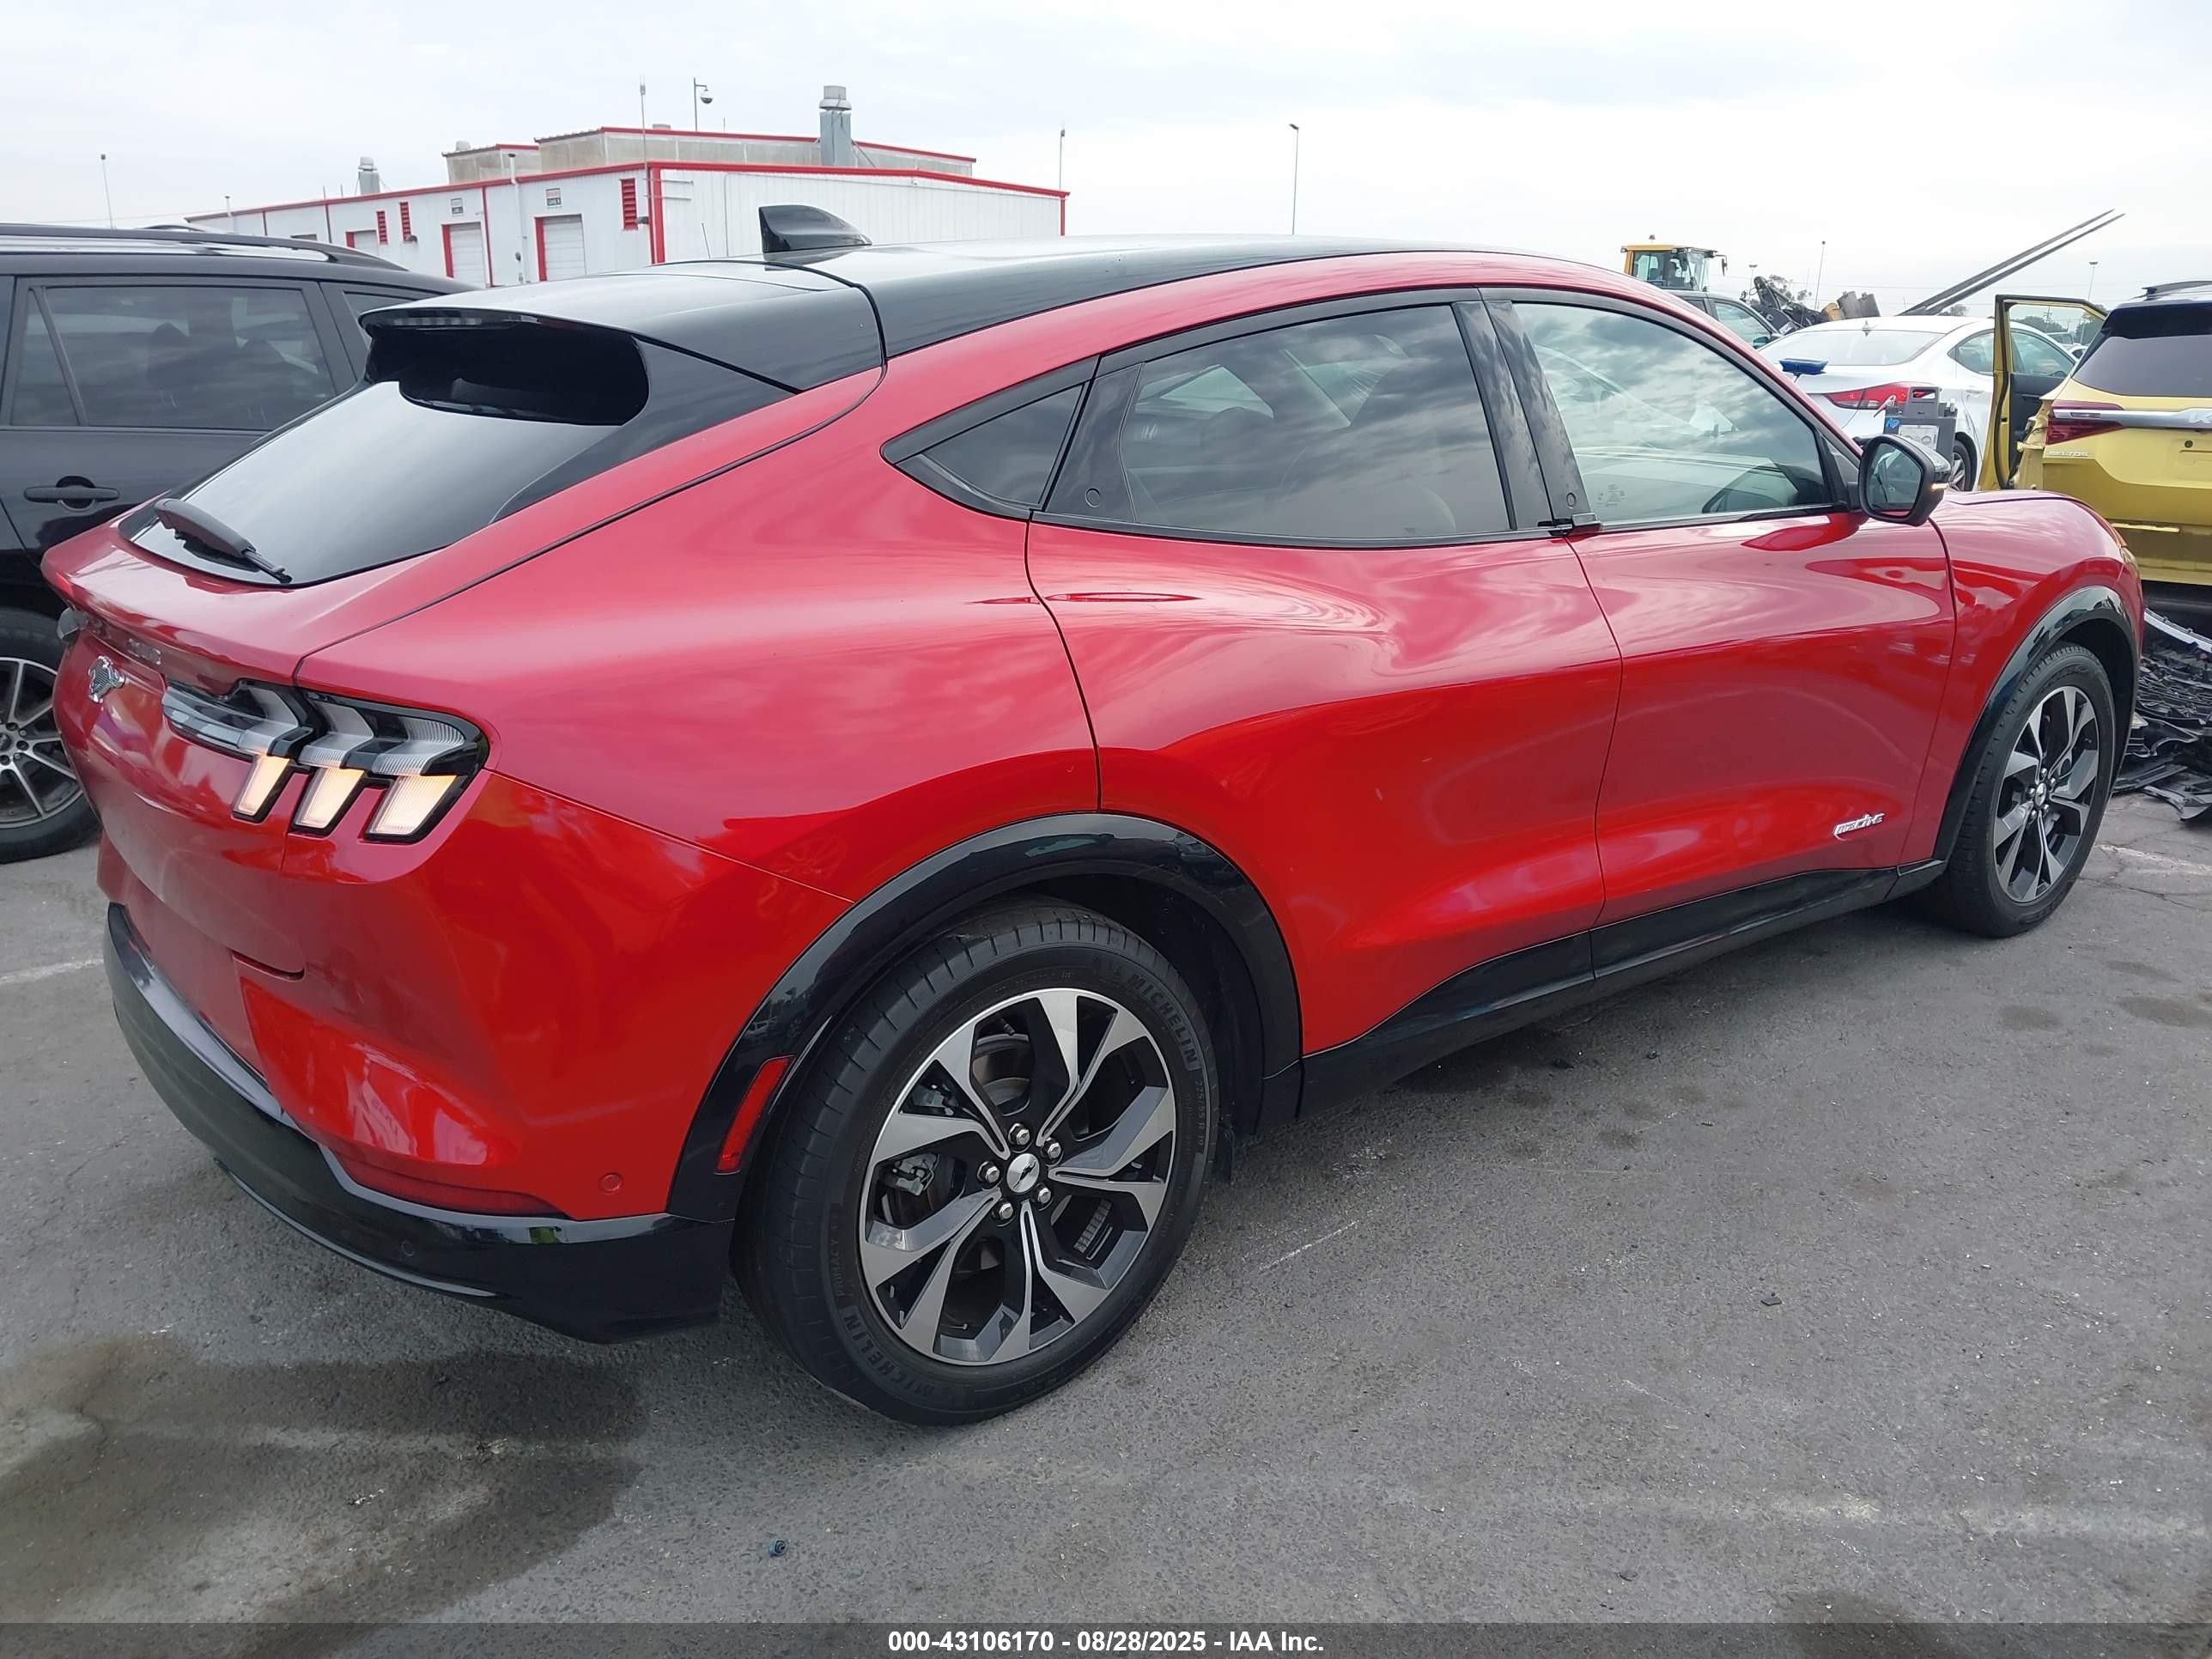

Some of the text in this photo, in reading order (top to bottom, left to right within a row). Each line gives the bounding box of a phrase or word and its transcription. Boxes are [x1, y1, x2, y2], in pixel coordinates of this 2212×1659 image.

[1127, 973, 1199, 1065] MICHELIN
[830, 1239, 847, 1297] PRIMACY
[842, 1313, 934, 1398] MICHELIN
